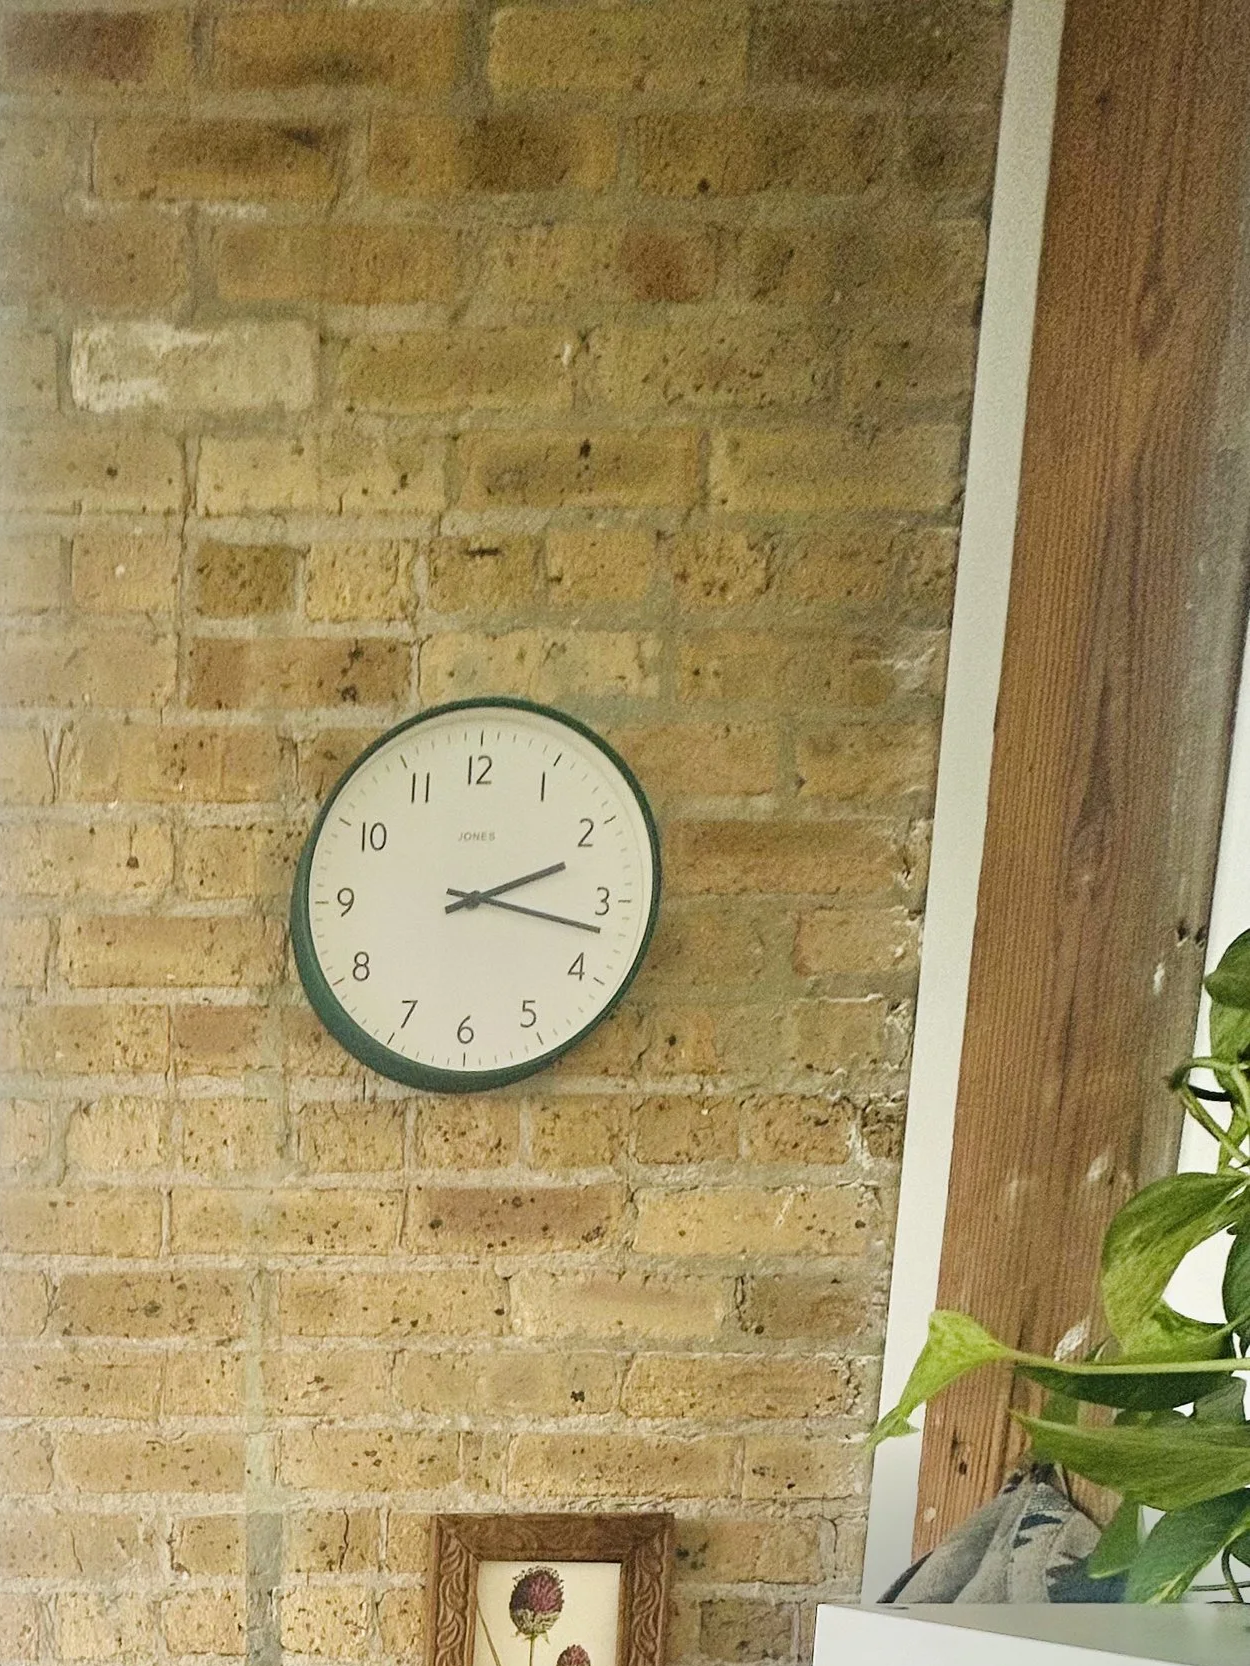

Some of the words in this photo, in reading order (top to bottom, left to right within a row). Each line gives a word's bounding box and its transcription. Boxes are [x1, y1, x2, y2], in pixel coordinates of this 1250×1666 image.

[466, 755, 493, 785] 12
[411, 772, 430, 803] 11
[361, 822, 388, 852] 10
[457, 831, 496, 842] JONES
[577, 818, 594, 848] 2
[337, 887, 355, 917] 9
[594, 886, 610, 916] 3
[352, 951, 370, 982] 8
[567, 952, 585, 981] 4
[401, 1000, 418, 1029] 7
[520, 1000, 537, 1028] 5
[457, 1015, 474, 1044] 6
